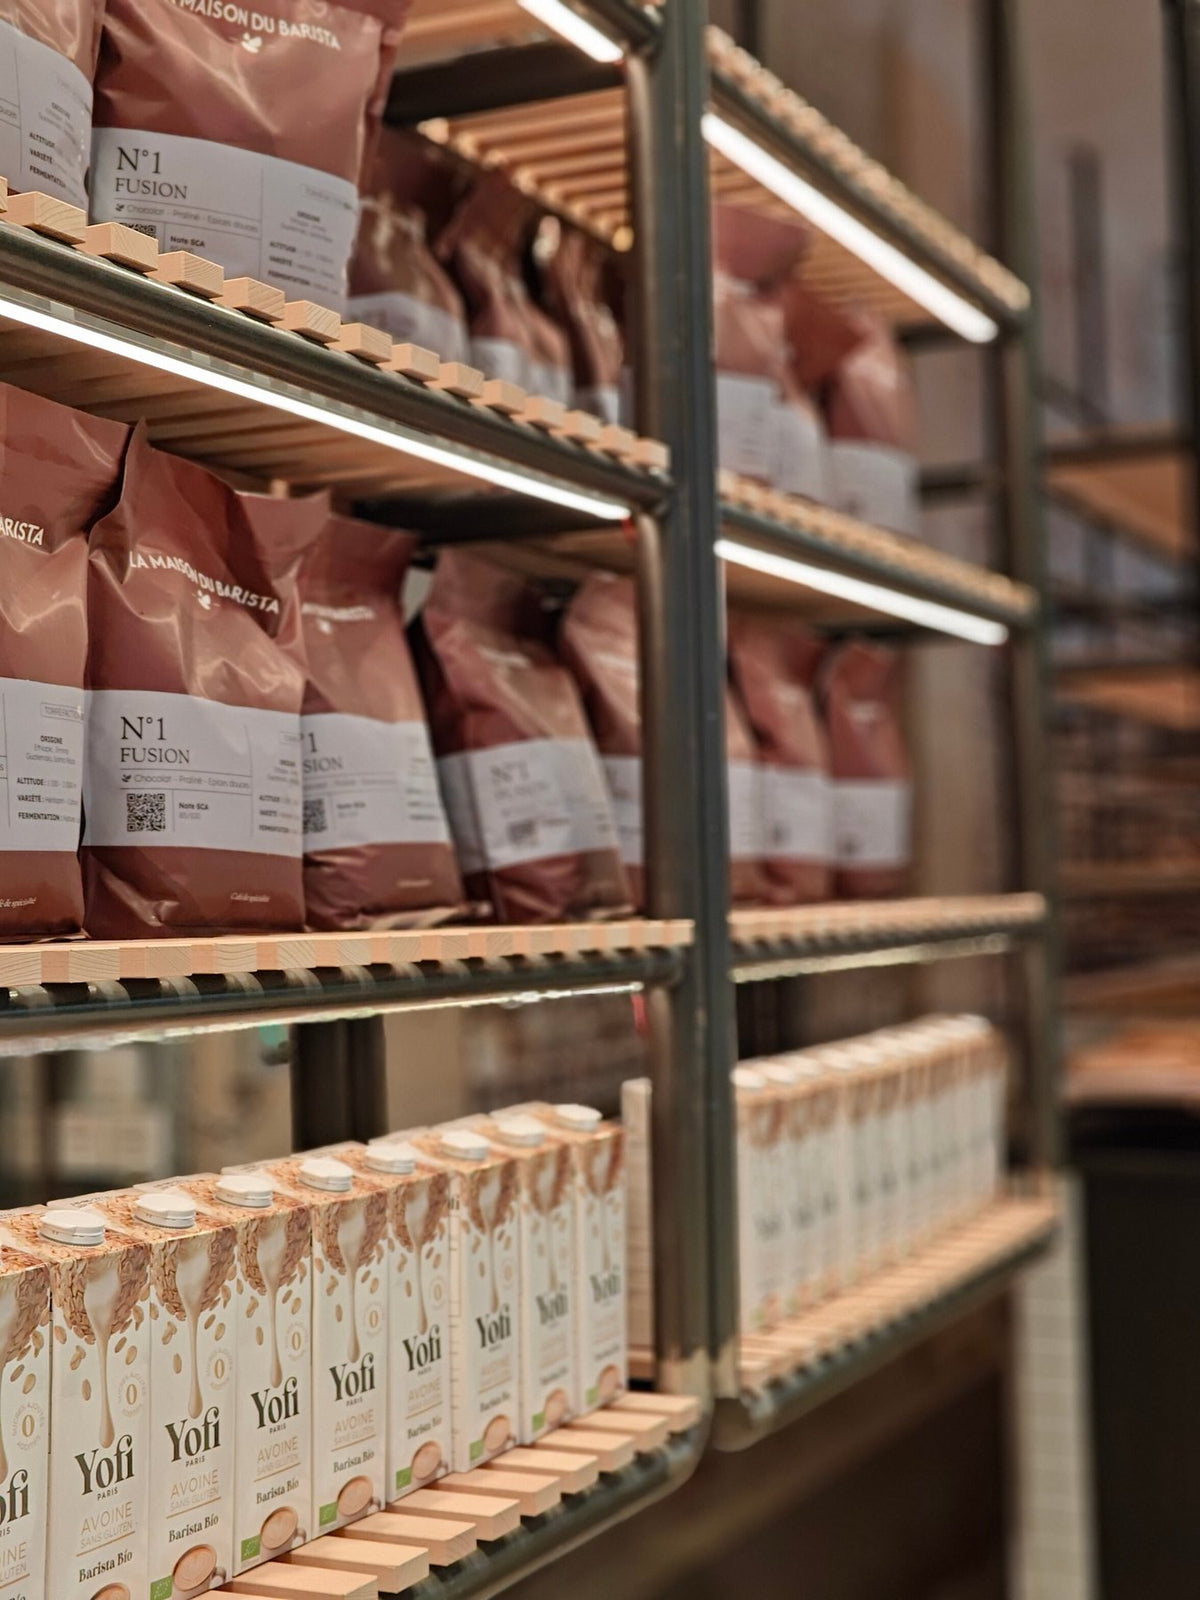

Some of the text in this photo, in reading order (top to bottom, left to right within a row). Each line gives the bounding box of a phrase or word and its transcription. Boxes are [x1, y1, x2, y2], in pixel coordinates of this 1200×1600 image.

[251, 13, 275, 33] DU
[279, 20, 341, 50] BARISTA
[117, 146, 161, 174] N°1
[115, 177, 187, 199] FUSION
[190, 238, 206, 248] SCA
[129, 550, 148, 569] LA
[148, 555, 198, 582] MAISON
[197, 573, 214, 592] DU
[214, 581, 279, 613] BARISTA
[120, 716, 166, 741] N°1
[120, 747, 190, 764] FUSION
[17, 777, 44, 786] ALTITUDE
[402, 1323, 442, 1372] Yofi
[329, 1352, 376, 1402] Yofi
[250, 1376, 300, 1429] Yofi
[165, 1406, 221, 1463] Yofi
[185, 1455, 205, 1467] PARIS
[256, 1435, 298, 1464] AVOINE
[75, 1434, 135, 1495] Yofi
[97, 1487, 118, 1500] PARIS
[170, 1469, 219, 1499] AVOINE
[256, 1487, 285, 1505] Barista
[80, 1501, 133, 1535] AVOINE
[168, 1524, 203, 1542] Barista
[79, 1561, 115, 1583] Barista
